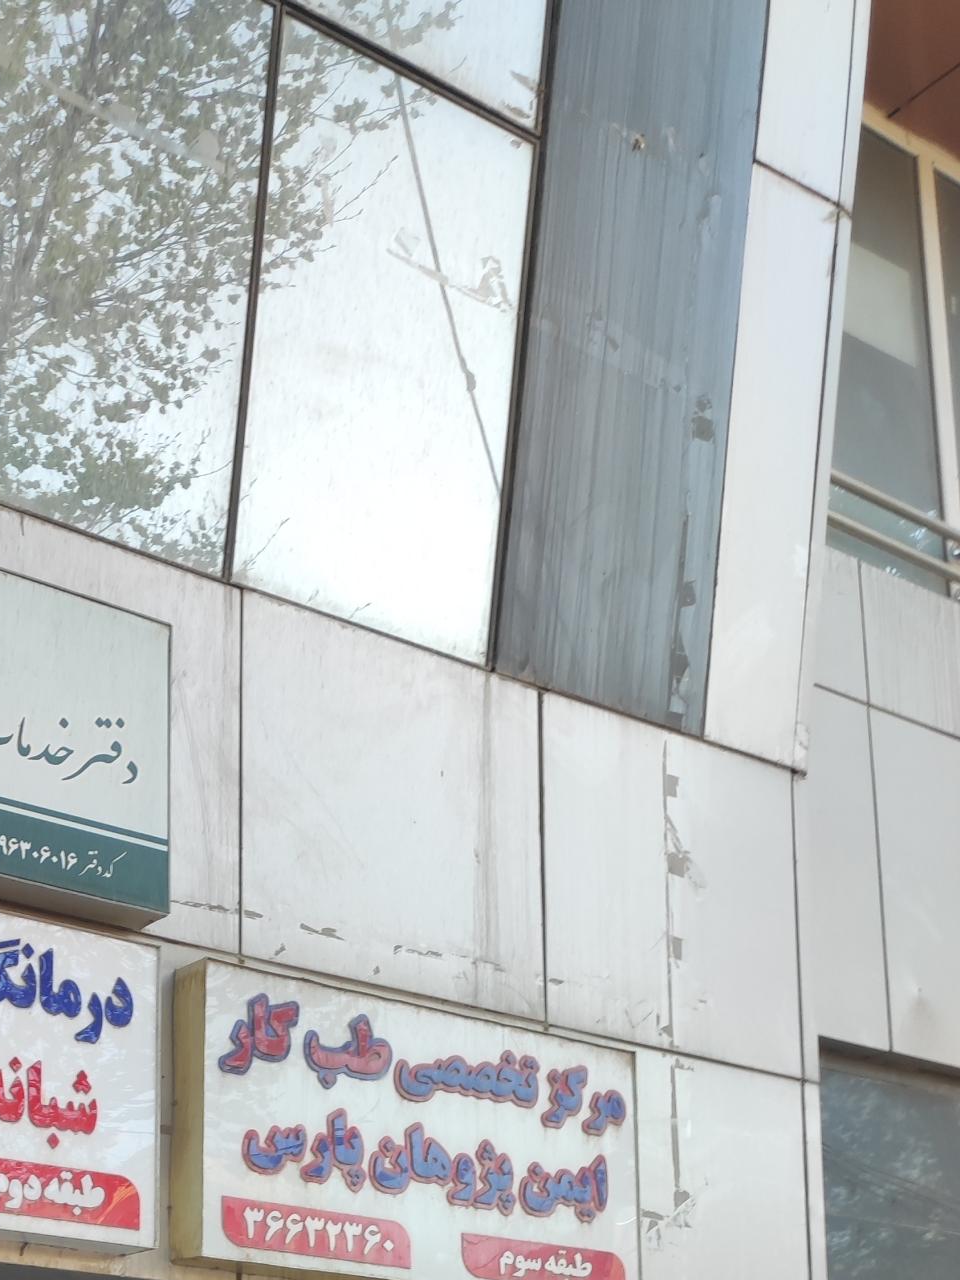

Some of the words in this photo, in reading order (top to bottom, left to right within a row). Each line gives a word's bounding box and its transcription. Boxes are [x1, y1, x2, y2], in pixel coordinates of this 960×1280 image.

[61, 717, 138, 785] دفتر
[78, 850, 102, 876] دفتر
[101, 851, 127, 878] کد
[218, 992, 299, 1075] کار
[303, 1013, 393, 1090] طب
[393, 1050, 540, 1108] تخصصی
[540, 1064, 626, 1136] مرکز
[241, 1107, 367, 1192] پارس
[368, 1121, 516, 1217] پژوهان
[43, 1170, 106, 1216] طبقه
[518, 1154, 609, 1223] ایمن
[243, 1205, 395, 1255] ۳۶۶۳۲۳۶۰
[498, 1249, 542, 1278] سوم
